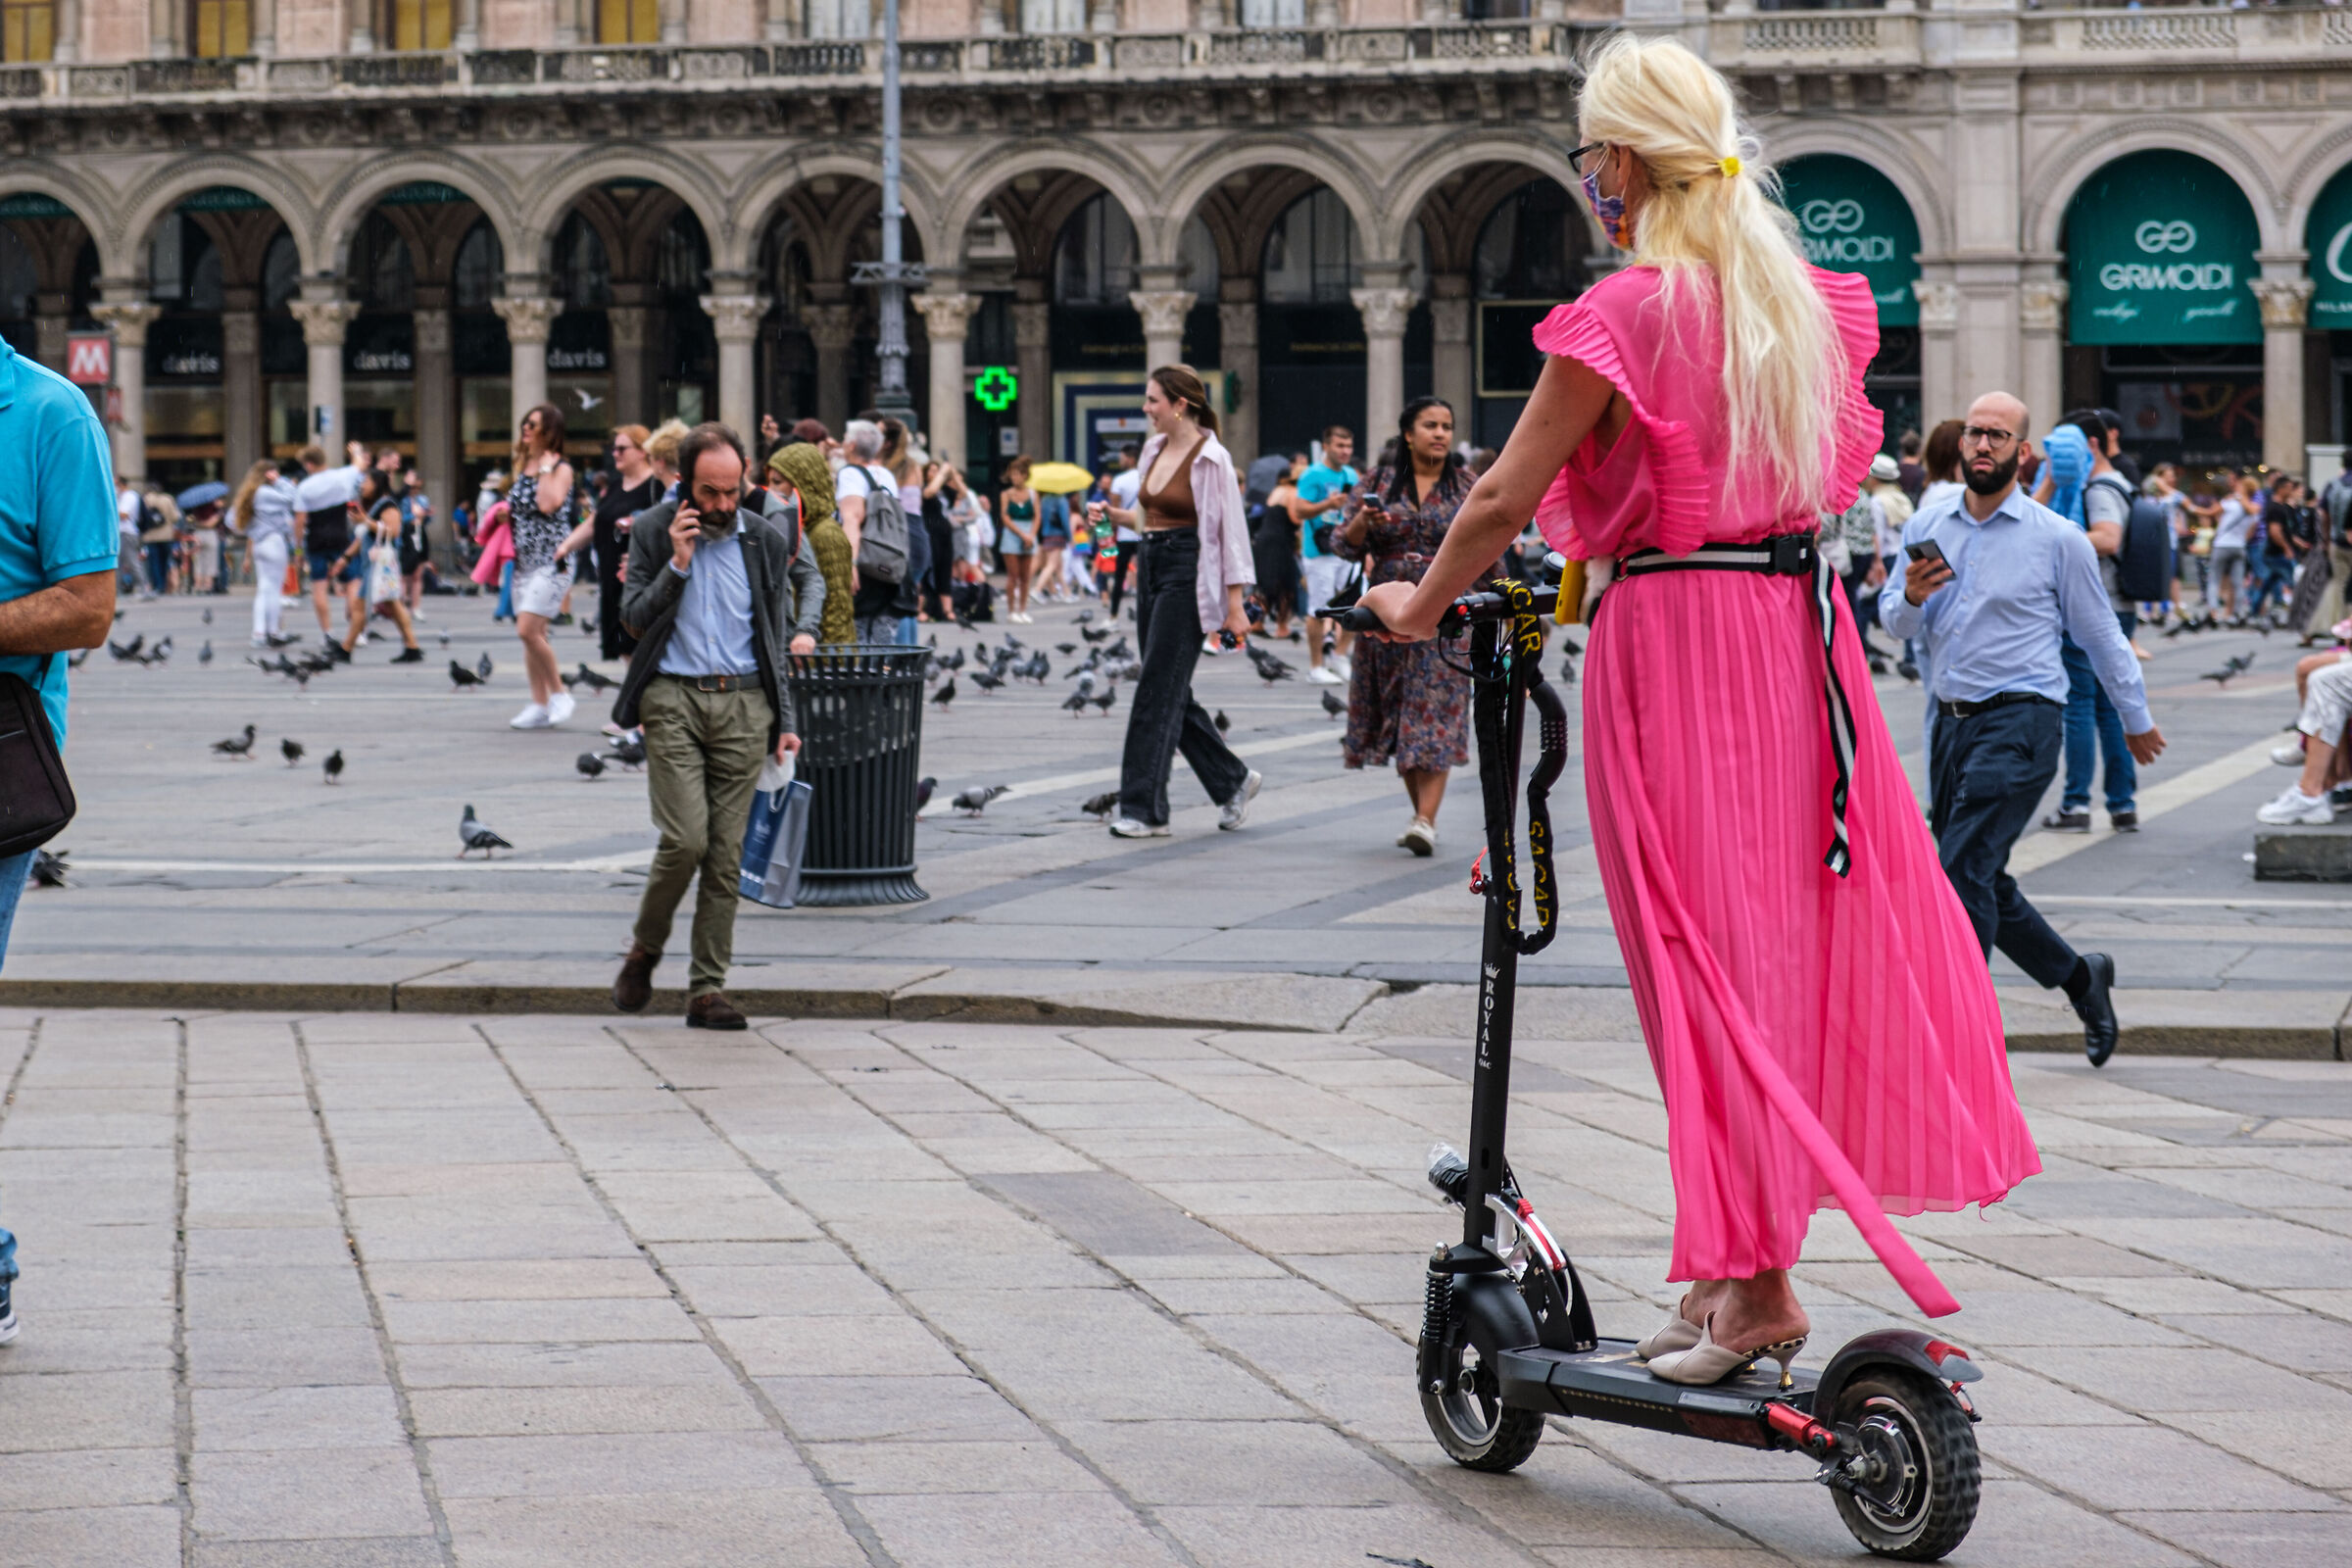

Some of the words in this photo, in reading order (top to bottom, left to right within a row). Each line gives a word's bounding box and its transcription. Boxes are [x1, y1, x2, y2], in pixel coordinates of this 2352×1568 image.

[2099, 264, 2233, 290] GRIMOLDI
[71, 344, 109, 374] M
[548, 347, 606, 368] davis
[1481, 980, 1494, 1056] ROYAL
